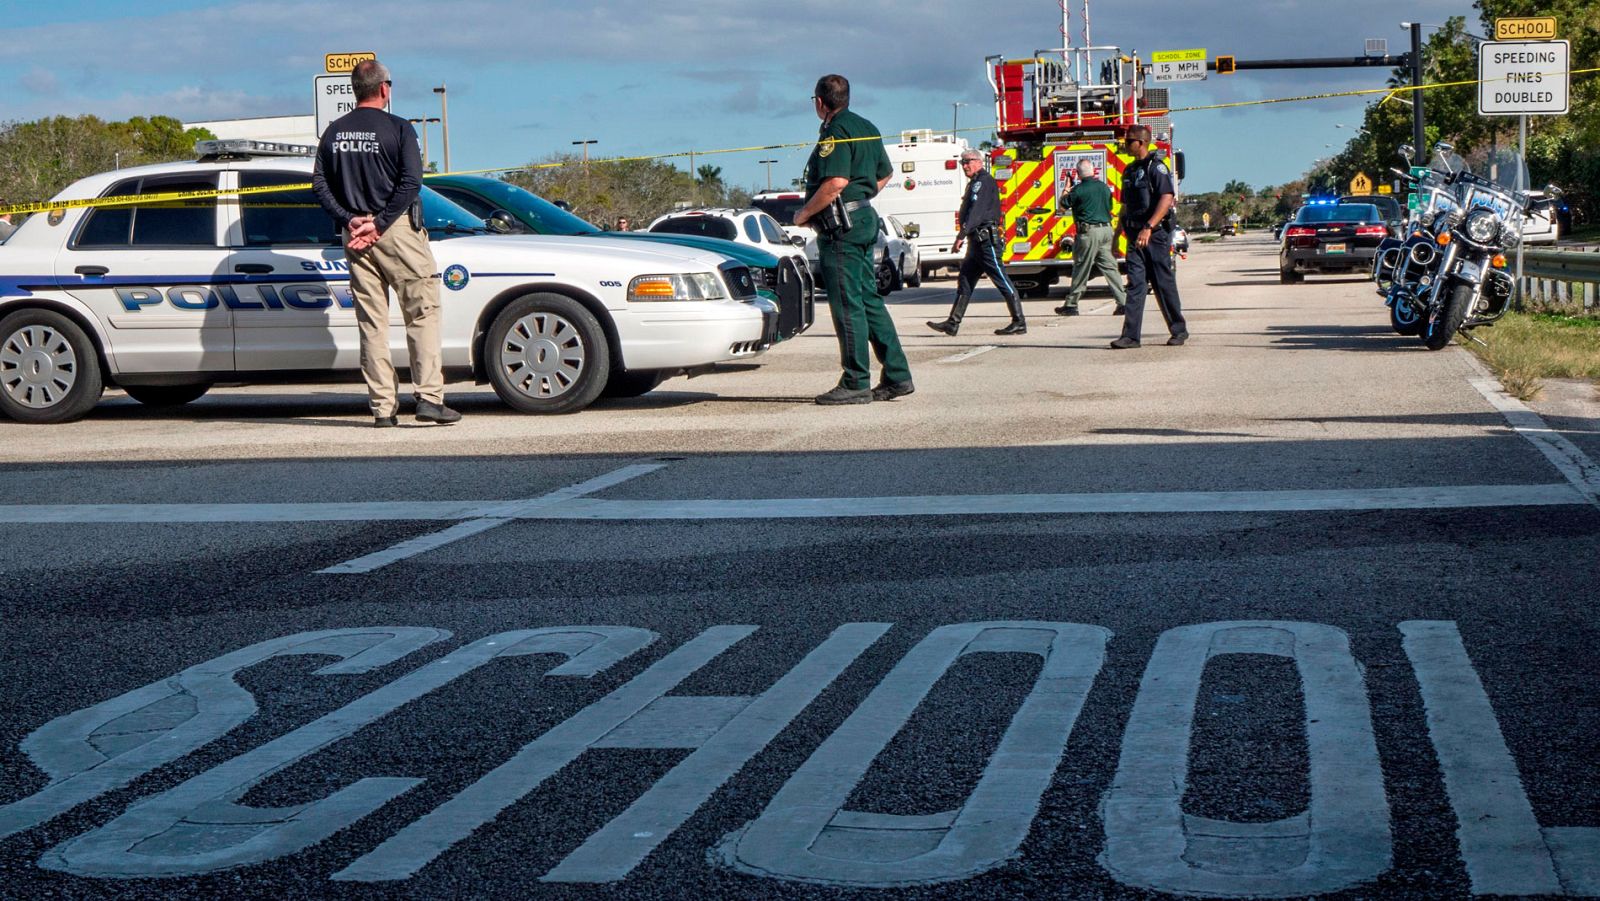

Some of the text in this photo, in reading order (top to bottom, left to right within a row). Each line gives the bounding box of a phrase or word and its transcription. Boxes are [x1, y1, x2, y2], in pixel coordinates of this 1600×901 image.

[1500, 23, 1552, 35] SCHOOL
[1184, 51, 1202, 59] ZONE
[1494, 52, 1556, 64] SPEEDING
[329, 57, 371, 69] SCHO
[1160, 62, 1199, 73] 15 MPH
[1506, 72, 1542, 83] FINES
[326, 84, 353, 95] SPEE
[1495, 92, 1553, 104] DOUBLED
[337, 102, 356, 112] FIN
[336, 131, 377, 141] SUNRISE
[332, 141, 380, 154] POLICE
